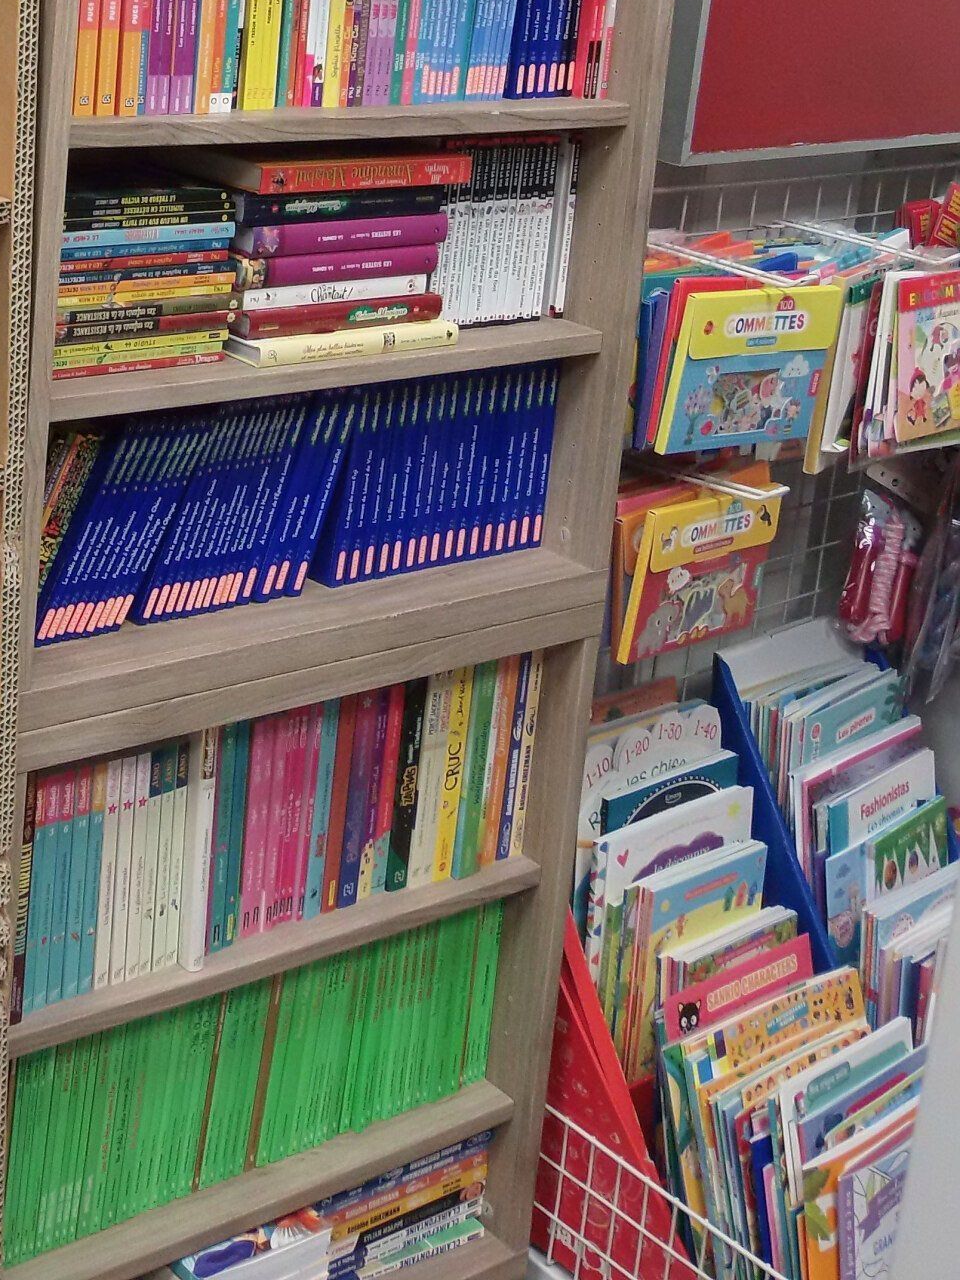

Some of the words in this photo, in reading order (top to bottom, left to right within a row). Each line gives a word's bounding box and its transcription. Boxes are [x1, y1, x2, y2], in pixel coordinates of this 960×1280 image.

[658, 722, 683, 741] 1-30
[693, 719, 718, 741] 1-40
[625, 737, 650, 765] 1-20
[586, 756, 610, 788] 1-10
[860, 780, 911, 821] Fashionistas
[707, 980, 741, 1012] SANRIO
[741, 953, 798, 996] CHARACTERS
